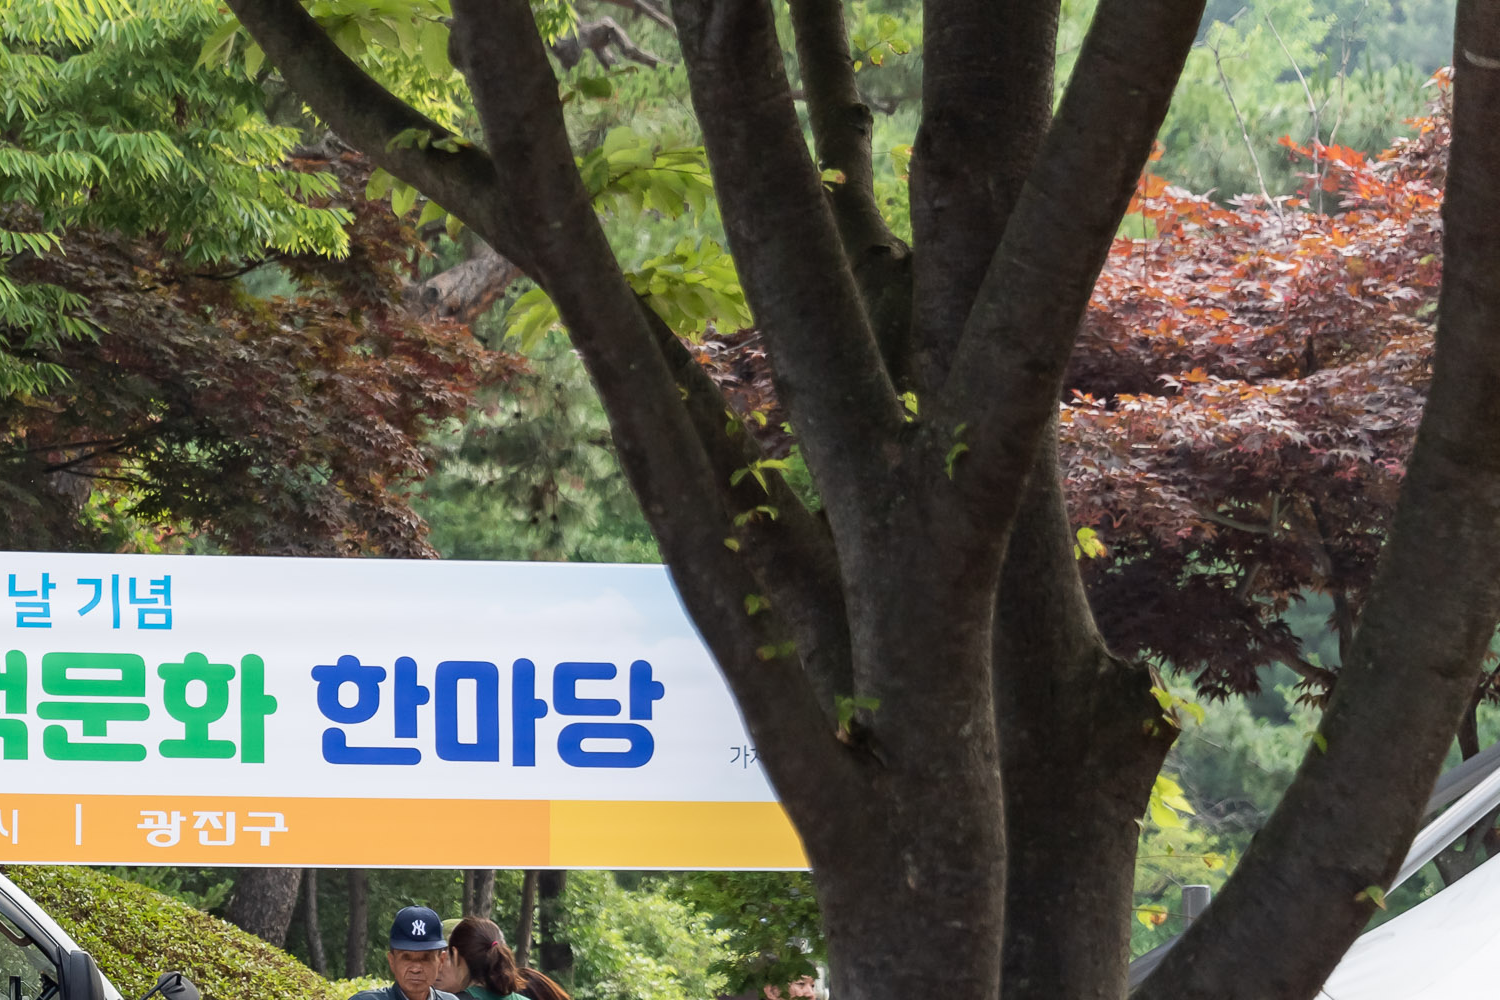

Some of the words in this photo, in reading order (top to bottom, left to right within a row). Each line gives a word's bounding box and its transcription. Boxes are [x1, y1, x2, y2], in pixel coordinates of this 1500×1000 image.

[8, 573, 56, 628] 날
[77, 574, 172, 630] 기념
[311, 655, 664, 768] 한마당
[137, 810, 289, 847] 광진구
[412, 919, 426, 936] NY
